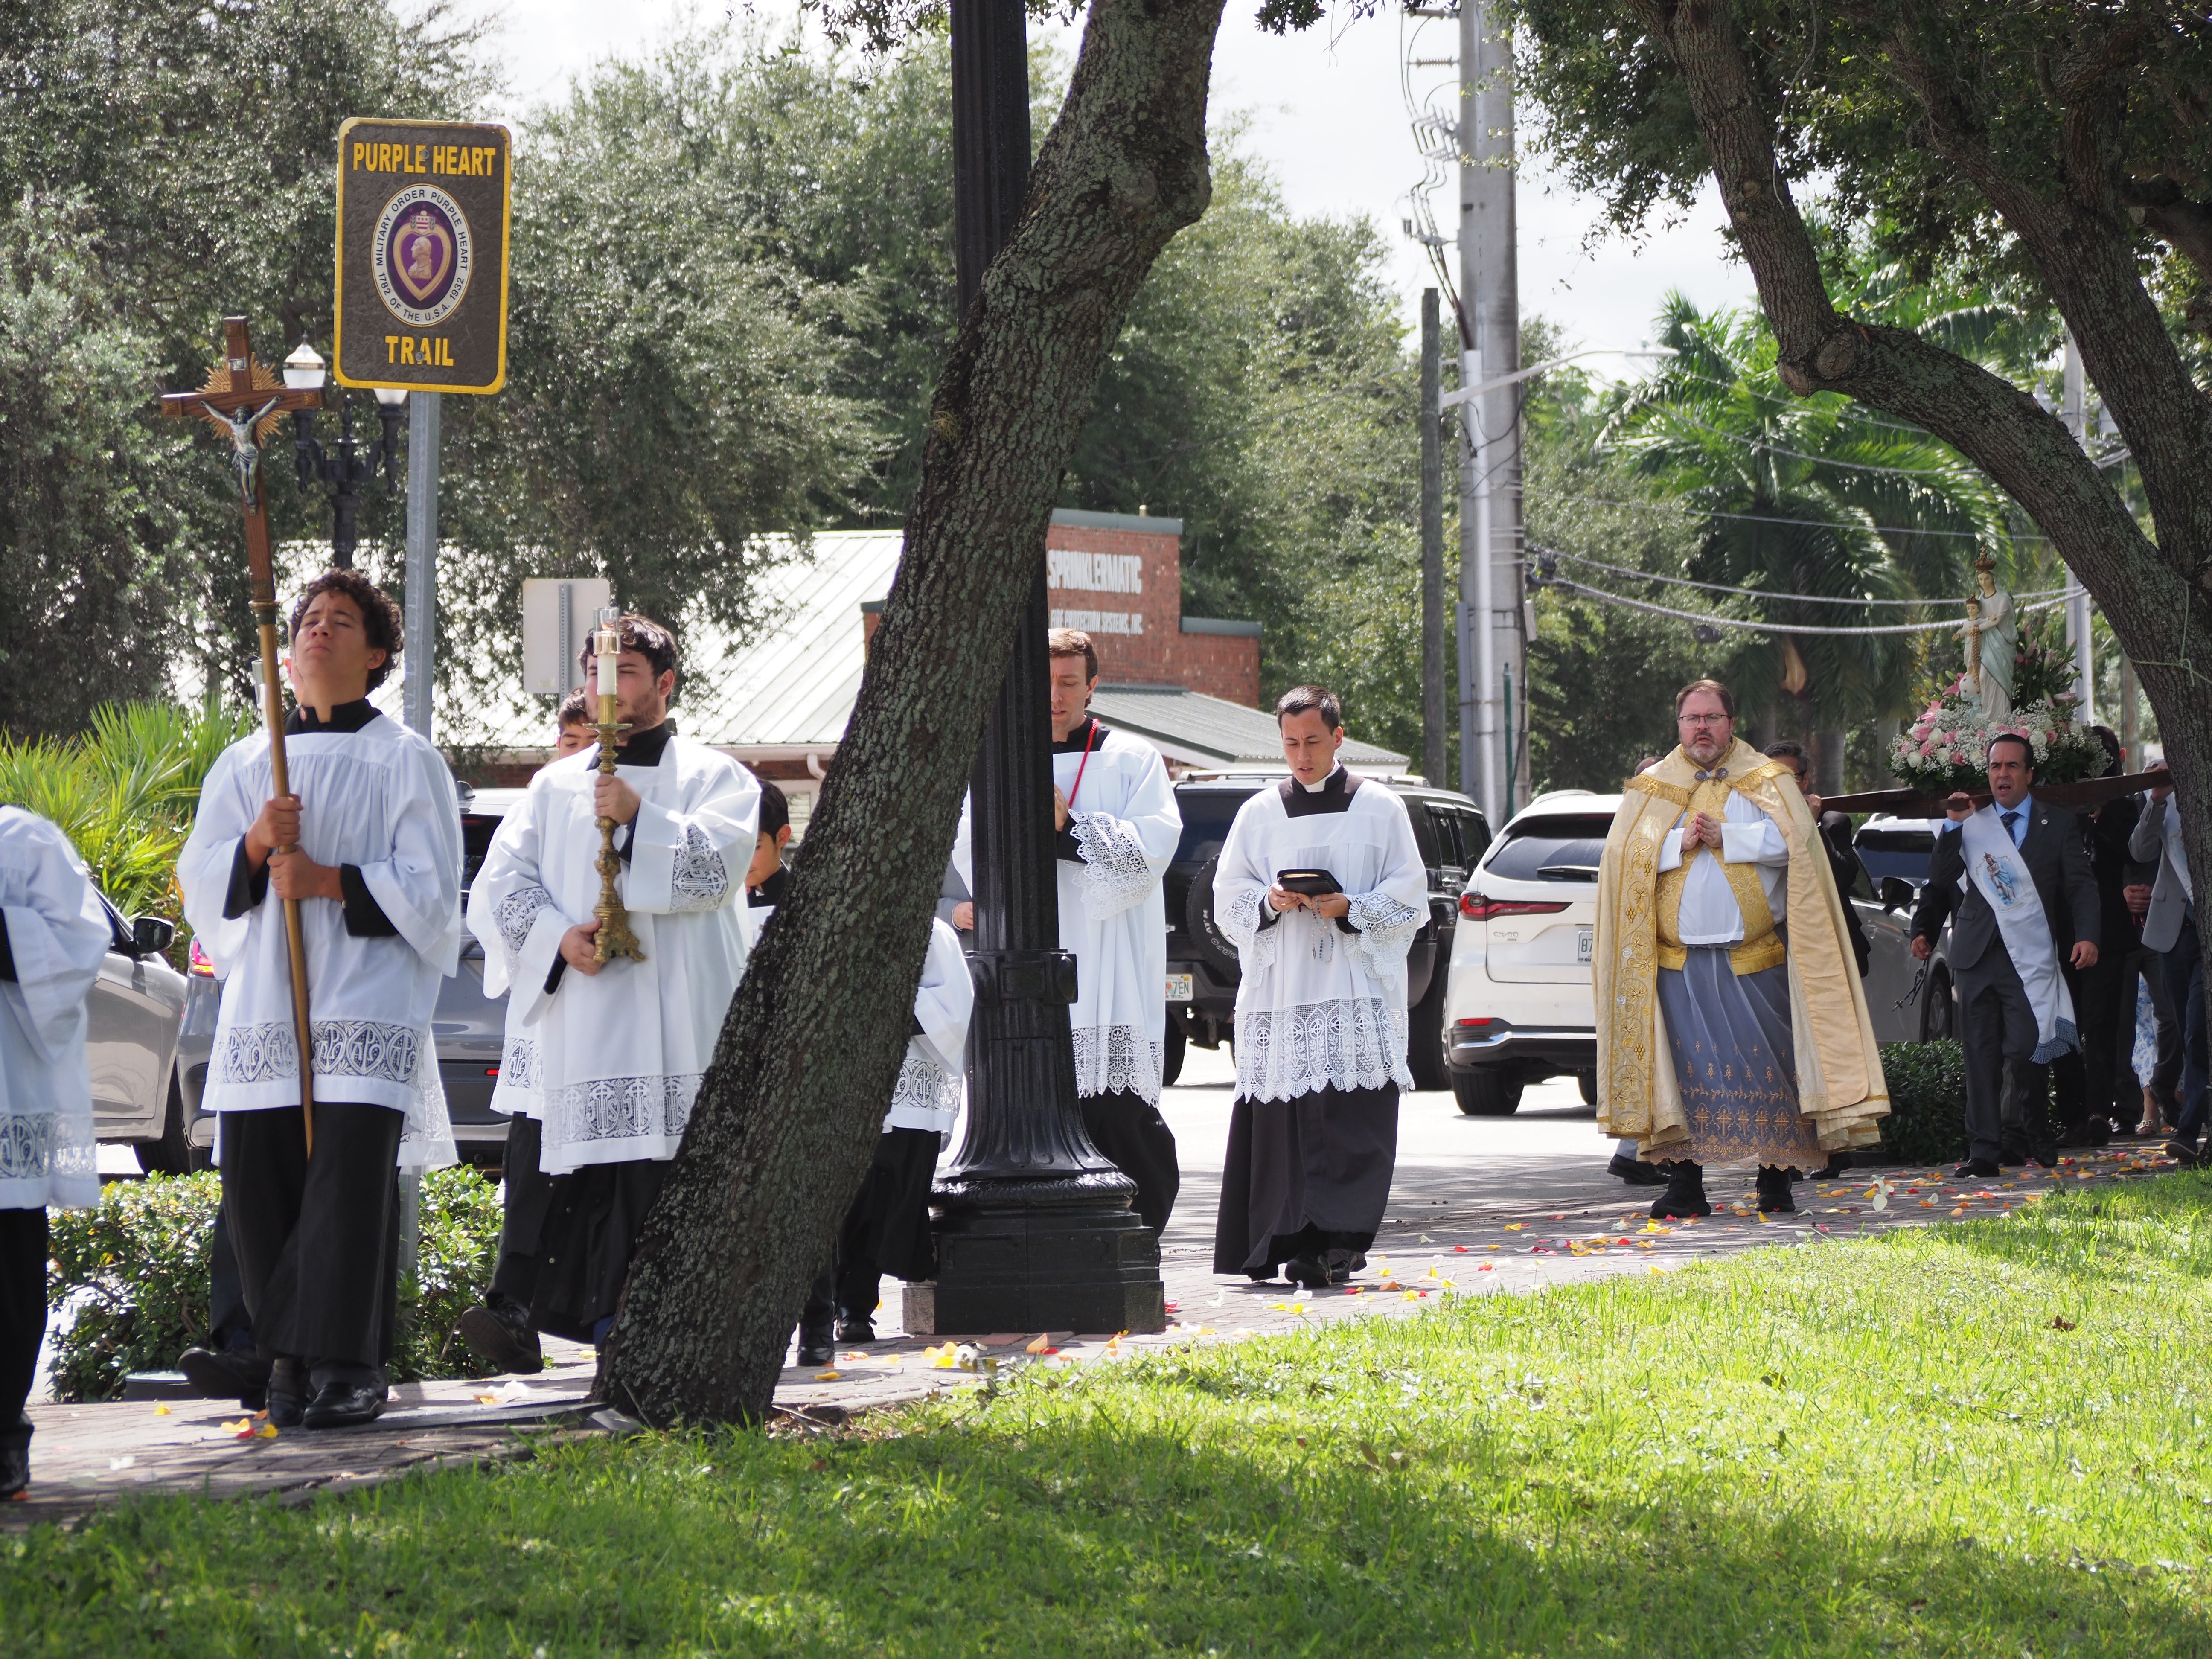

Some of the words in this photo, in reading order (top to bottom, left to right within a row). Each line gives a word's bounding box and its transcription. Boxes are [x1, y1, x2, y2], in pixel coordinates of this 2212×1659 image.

[353, 143, 426, 173] PURPLE
[432, 146, 495, 176] HEART
[375, 214, 391, 266] MILITARY
[391, 189, 425, 212] ORDER
[430, 191, 462, 227] PURPLE
[458, 232, 468, 271] HEART
[378, 272, 391, 295] 1782
[390, 298, 402, 310] OF
[403, 309, 420, 322] THE
[425, 304, 451, 321] U.S.A.
[449, 277, 465, 300] 1932
[385, 336, 454, 366] TRAIL
[1048, 549, 1142, 594] SPRINKLERMATIC
[1050, 609, 1064, 629] FIRE
[1065, 610, 1100, 633] PROTECTION
[1211, 938, 1239, 960] apro
[1581, 938, 1593, 952] 87
